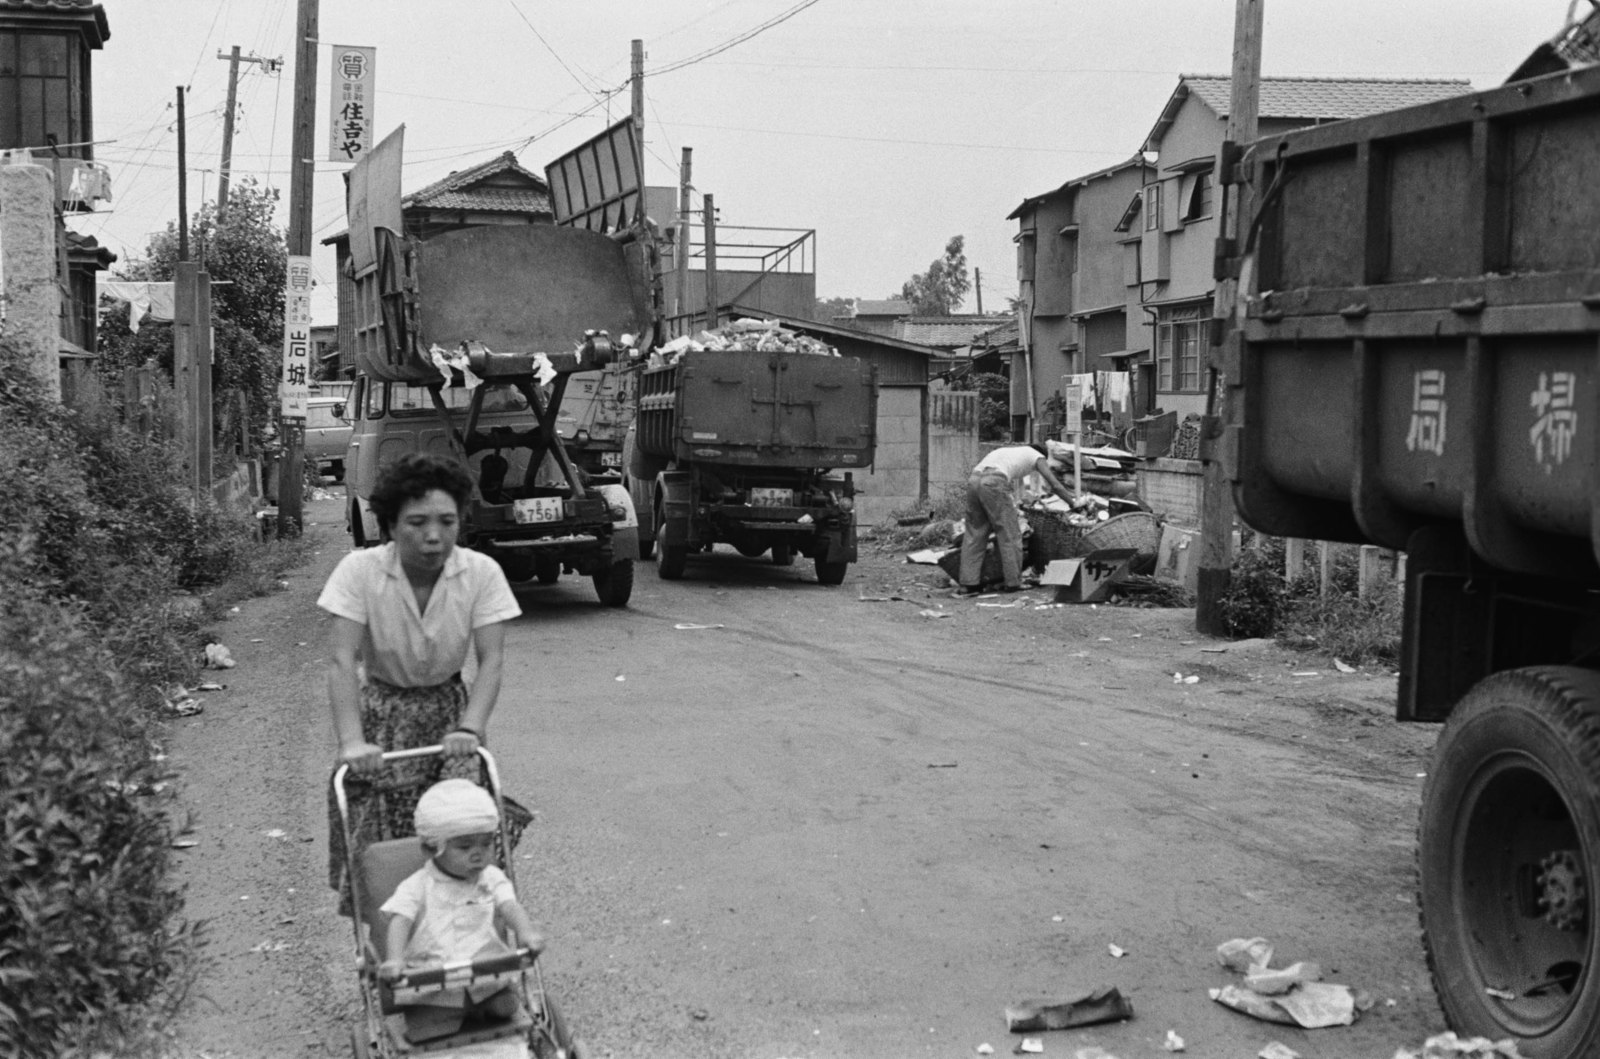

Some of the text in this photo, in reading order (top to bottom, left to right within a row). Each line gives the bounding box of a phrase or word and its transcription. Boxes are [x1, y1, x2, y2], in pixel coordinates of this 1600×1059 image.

[342, 55, 363, 79] 質
[340, 102, 364, 160] 住吉や
[291, 266, 309, 289] 質
[287, 330, 307, 386] 岩城
[527, 507, 561, 521] 7561
